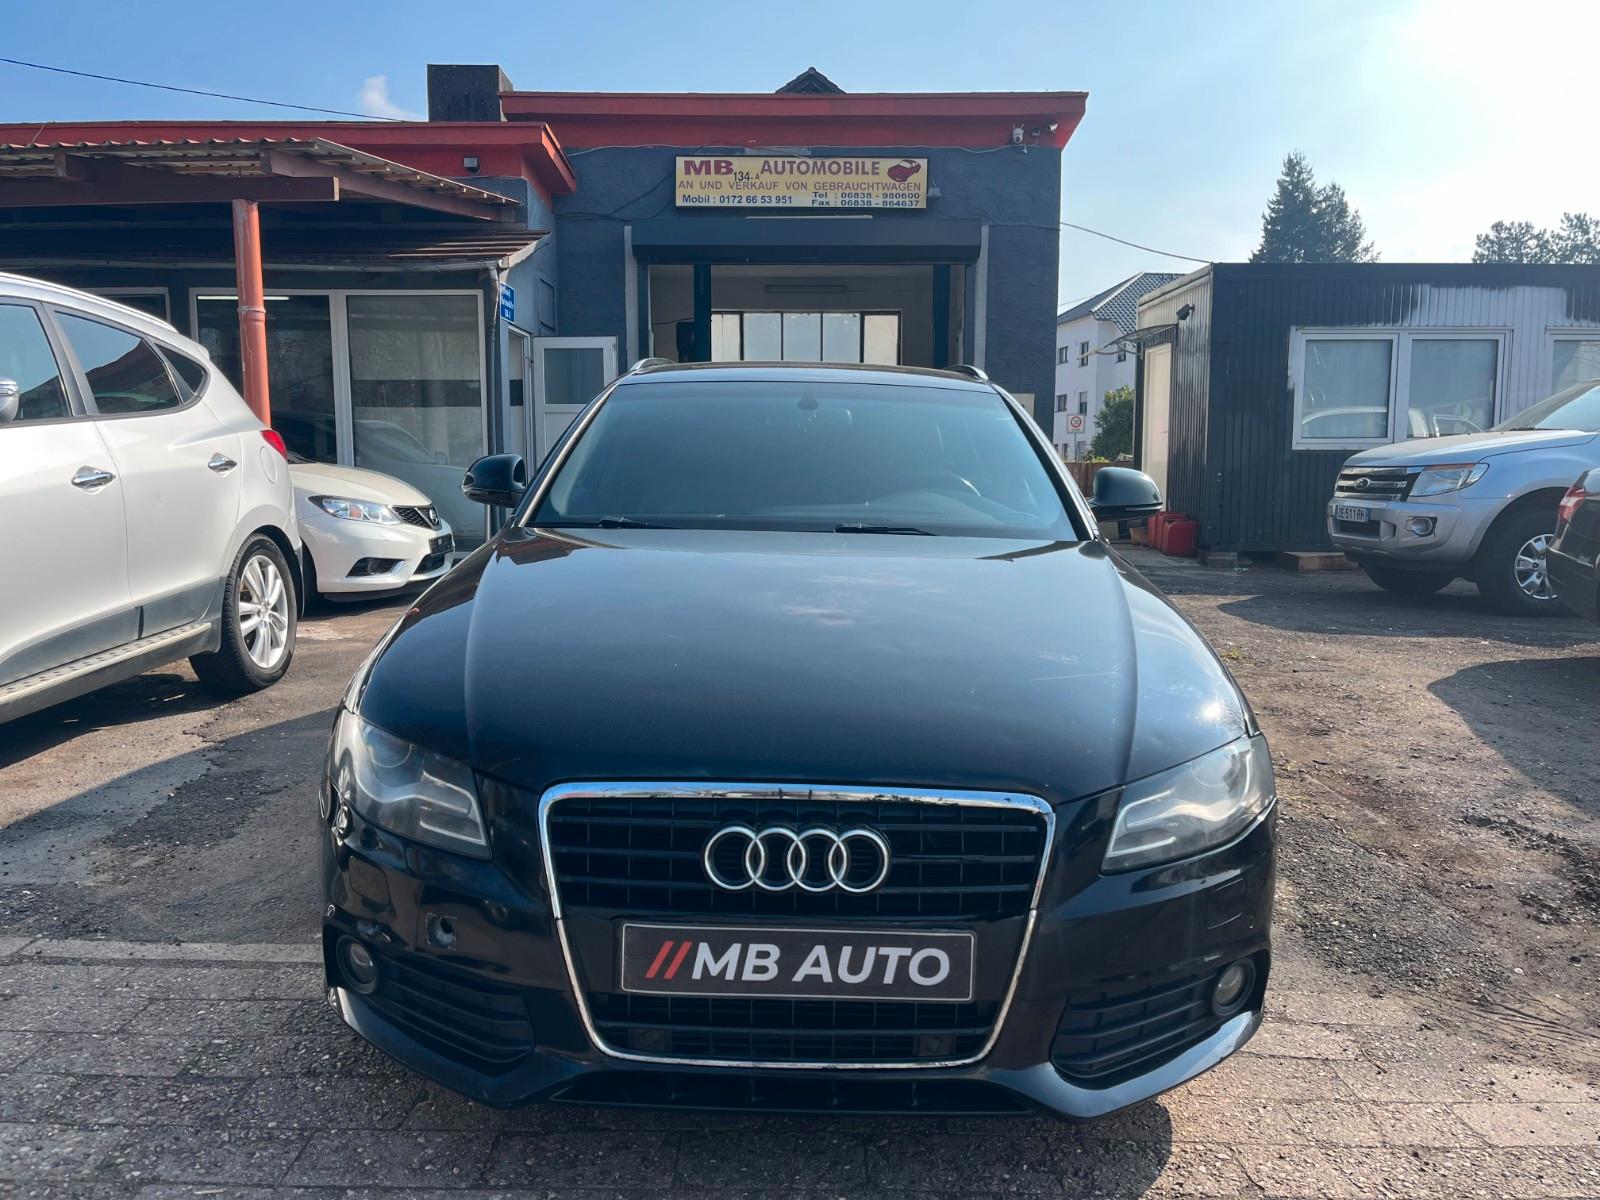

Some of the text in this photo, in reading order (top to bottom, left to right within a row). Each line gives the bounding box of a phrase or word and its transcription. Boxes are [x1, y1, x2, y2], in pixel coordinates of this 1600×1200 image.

[684, 160, 880, 175] MB AUTOMOBILE
[678, 181, 921, 191] AN UND VERKAUF VON GEBRAUCHTWAGEN
[682, 194, 710, 204] Mobil
[719, 195, 743, 204] 0172
[745, 195, 758, 204] 66
[760, 195, 773, 204] 53
[775, 195, 792, 204] 951
[791, 945, 950, 986] AUTO
